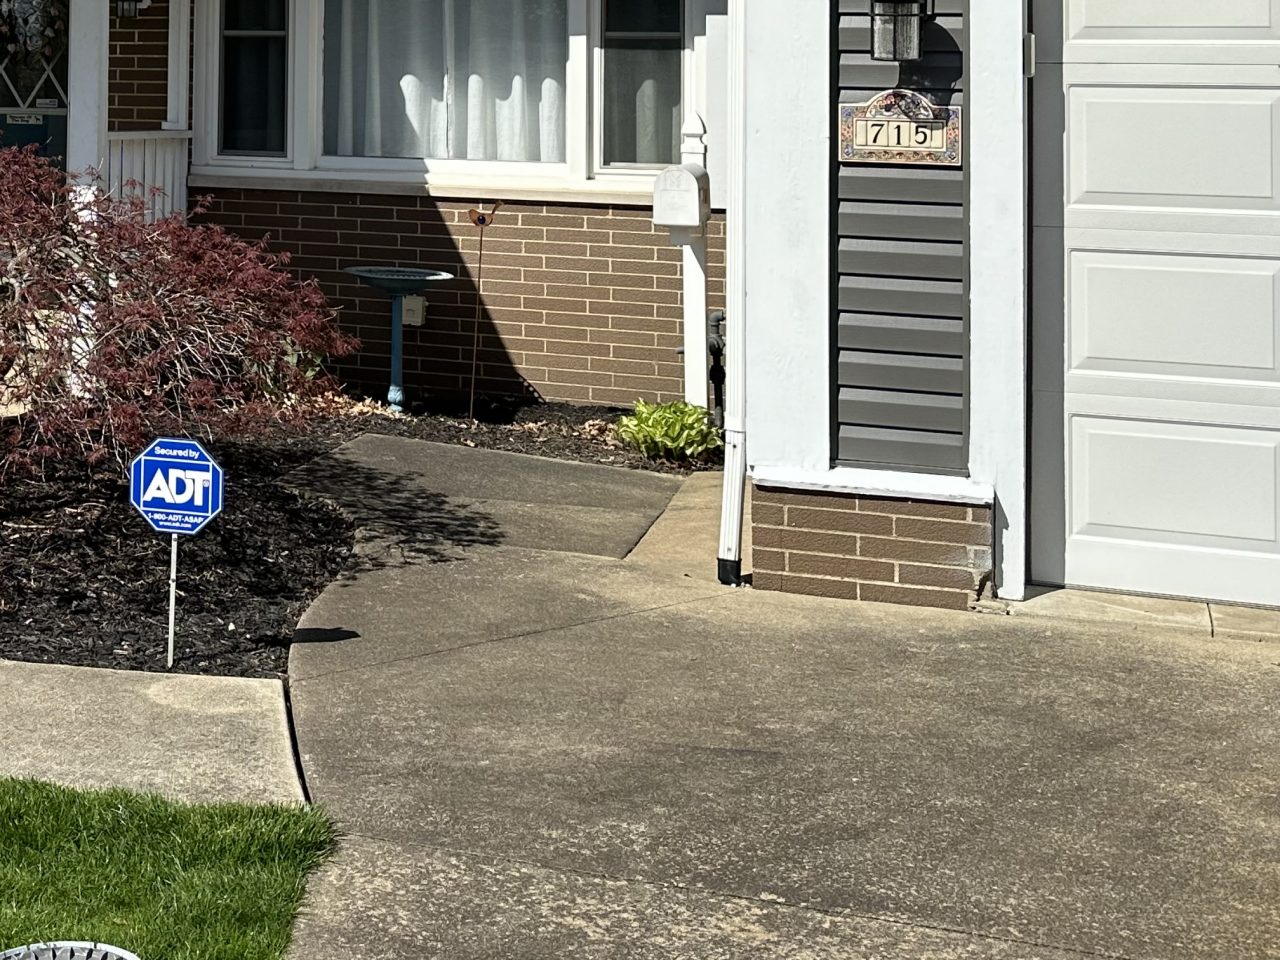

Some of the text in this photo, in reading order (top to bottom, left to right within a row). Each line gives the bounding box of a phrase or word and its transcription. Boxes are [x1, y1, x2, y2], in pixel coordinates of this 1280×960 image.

[871, 123, 928, 145] 715
[155, 446, 199, 459] Secured by
[143, 468, 210, 506] ADT
